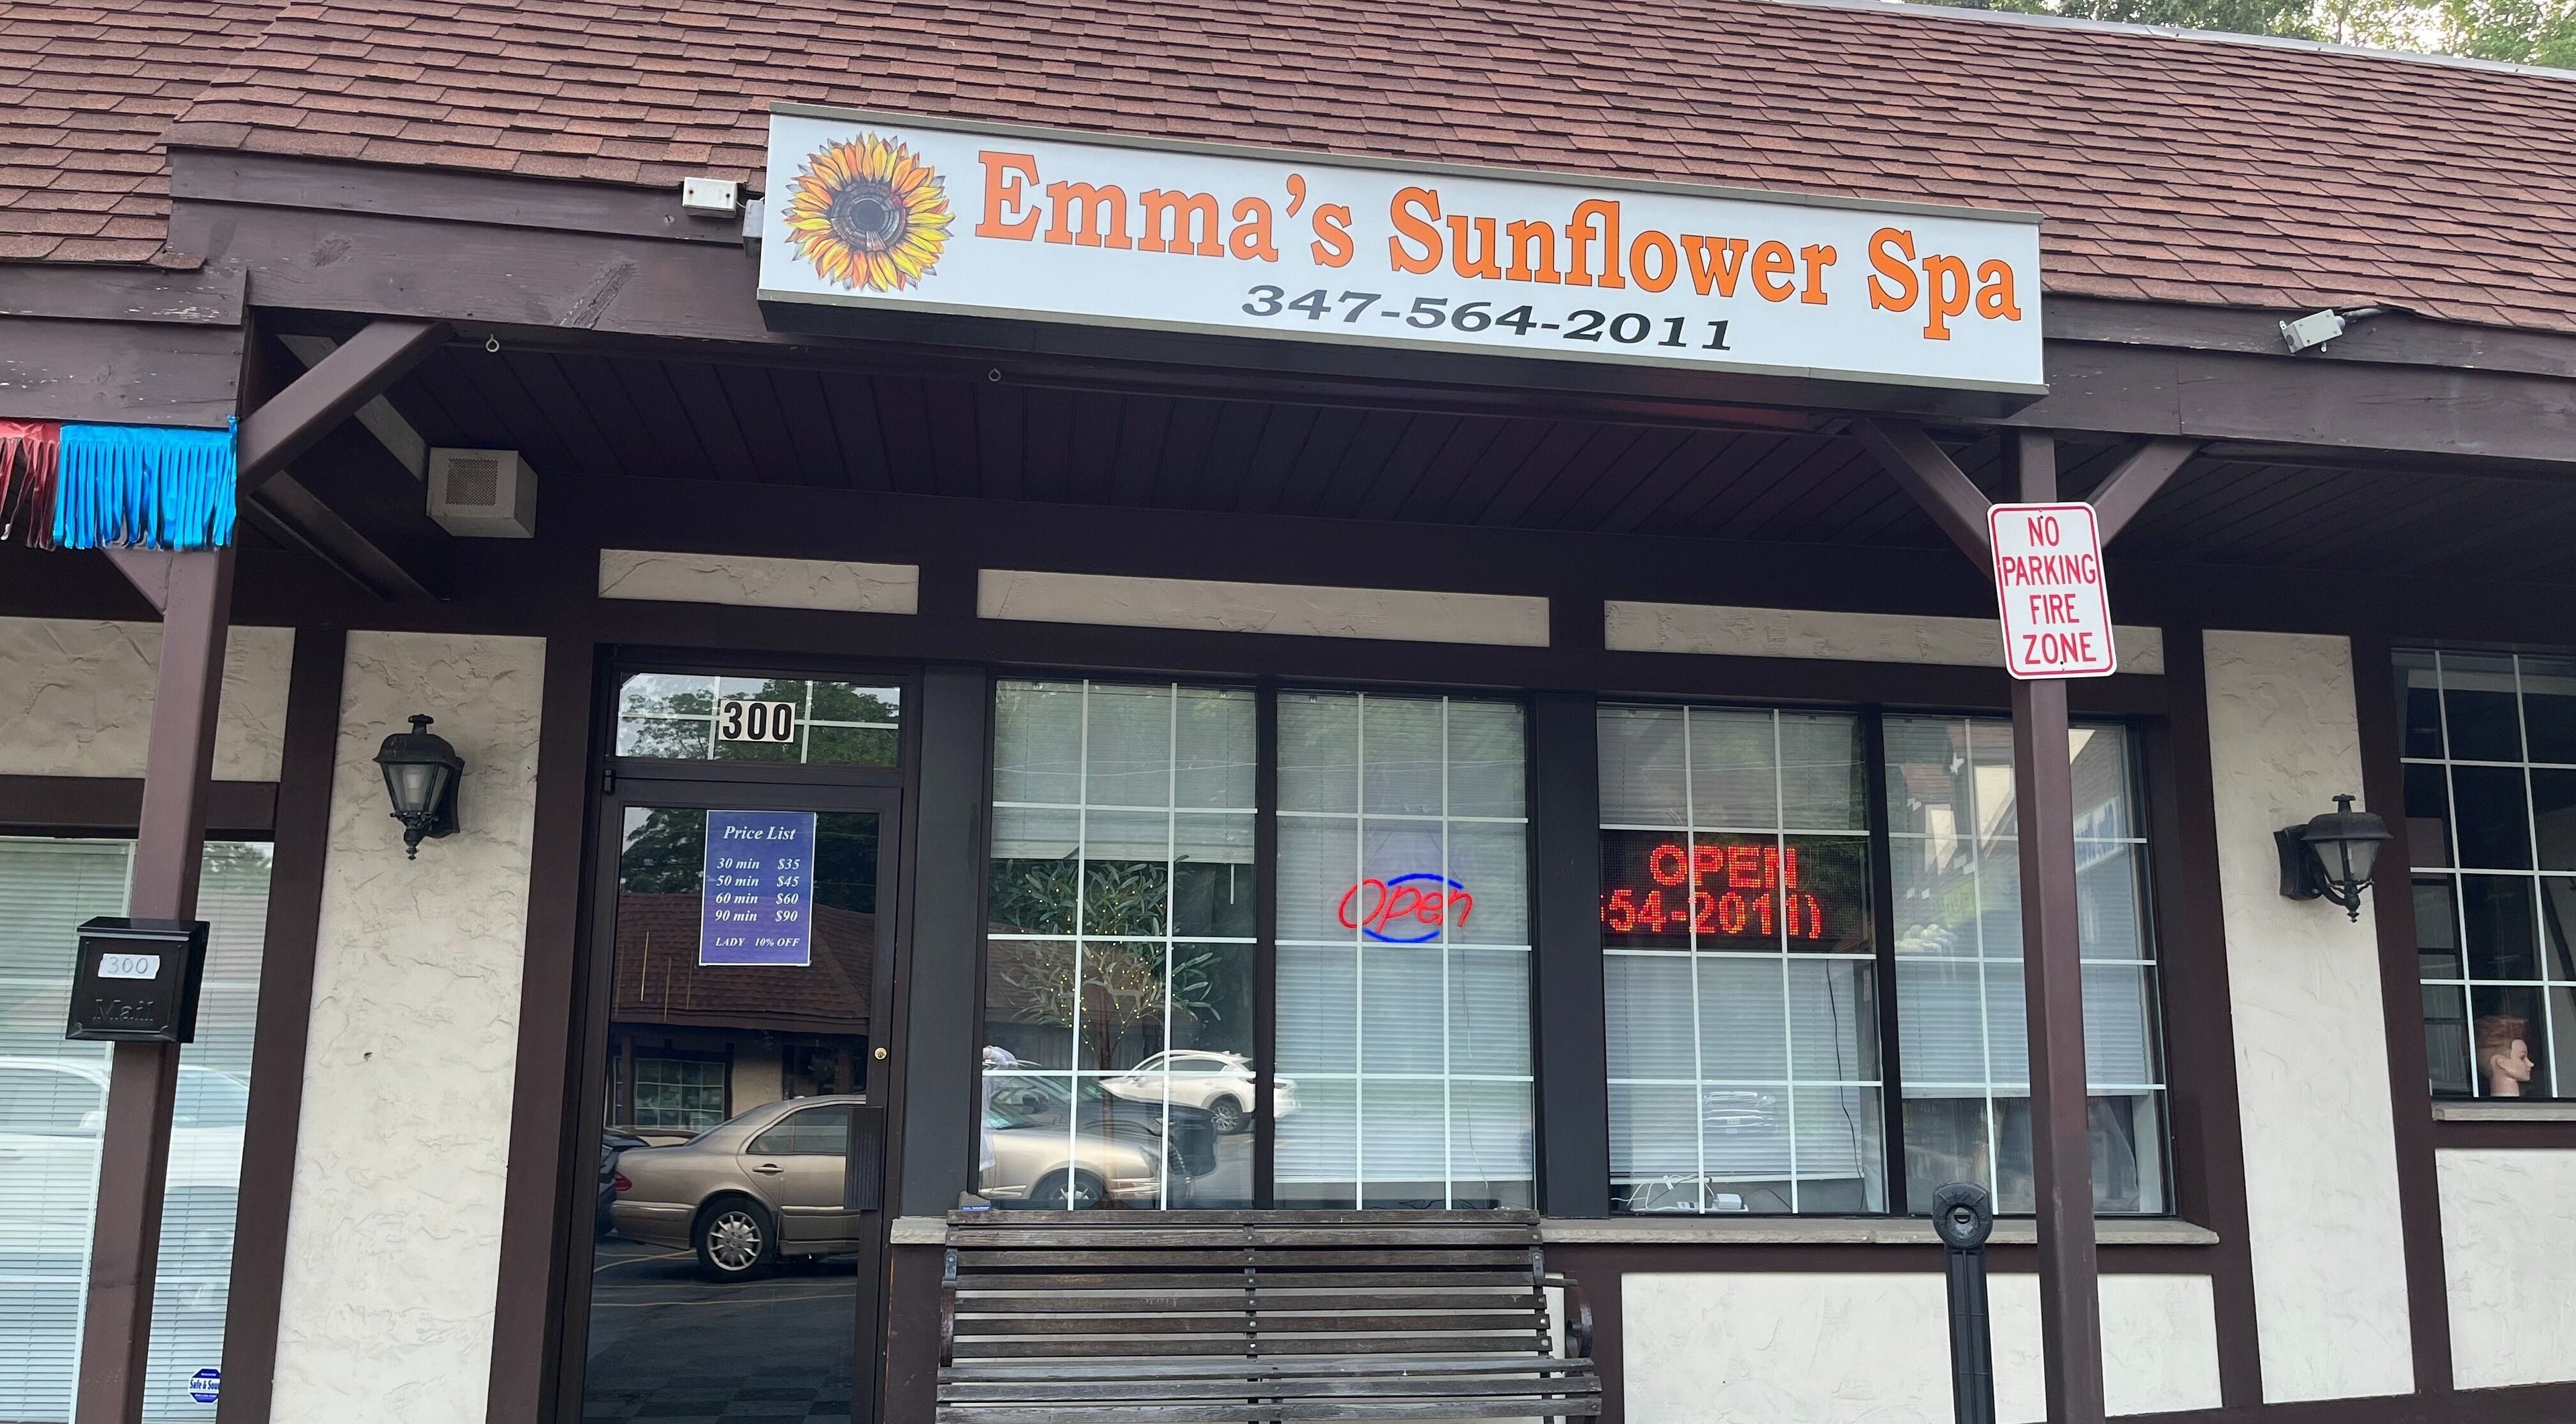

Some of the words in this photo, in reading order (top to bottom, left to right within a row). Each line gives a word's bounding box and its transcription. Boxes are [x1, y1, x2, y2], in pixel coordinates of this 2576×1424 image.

[1389, 186, 1837, 306] Sunflower
[1867, 227, 2021, 341] Spa
[1241, 284, 1732, 351] 347-564-2011
[2027, 516, 2059, 546] NO
[2002, 553, 2096, 586] PARKING
[2029, 594, 2080, 624] FIRE
[2023, 632, 2097, 665] ZONE
[722, 702, 792, 741] 300
[722, 826, 764, 840] Price
[765, 826, 796, 840] List
[717, 858, 733, 869] 30
[736, 858, 760, 869] min
[777, 859, 800, 871] $35
[1650, 844, 1797, 889] OPEN
[716, 875, 733, 887] 50
[735, 875, 759, 887] min
[777, 876, 800, 887] $45
[716, 893, 732, 904] 60
[735, 893, 759, 904] min
[776, 893, 799, 905] $60
[1338, 879, 1472, 933] Open
[1600, 889, 1822, 939] 54-2011)
[714, 910, 731, 922] 90
[733, 910, 757, 922] min
[775, 910, 798, 922] $90
[715, 937, 745, 946] LADY
[755, 938, 774, 947] 10%
[777, 938, 800, 947] OFF
[107, 956, 148, 974] 300
[189, 1379, 202, 1389] Safe
